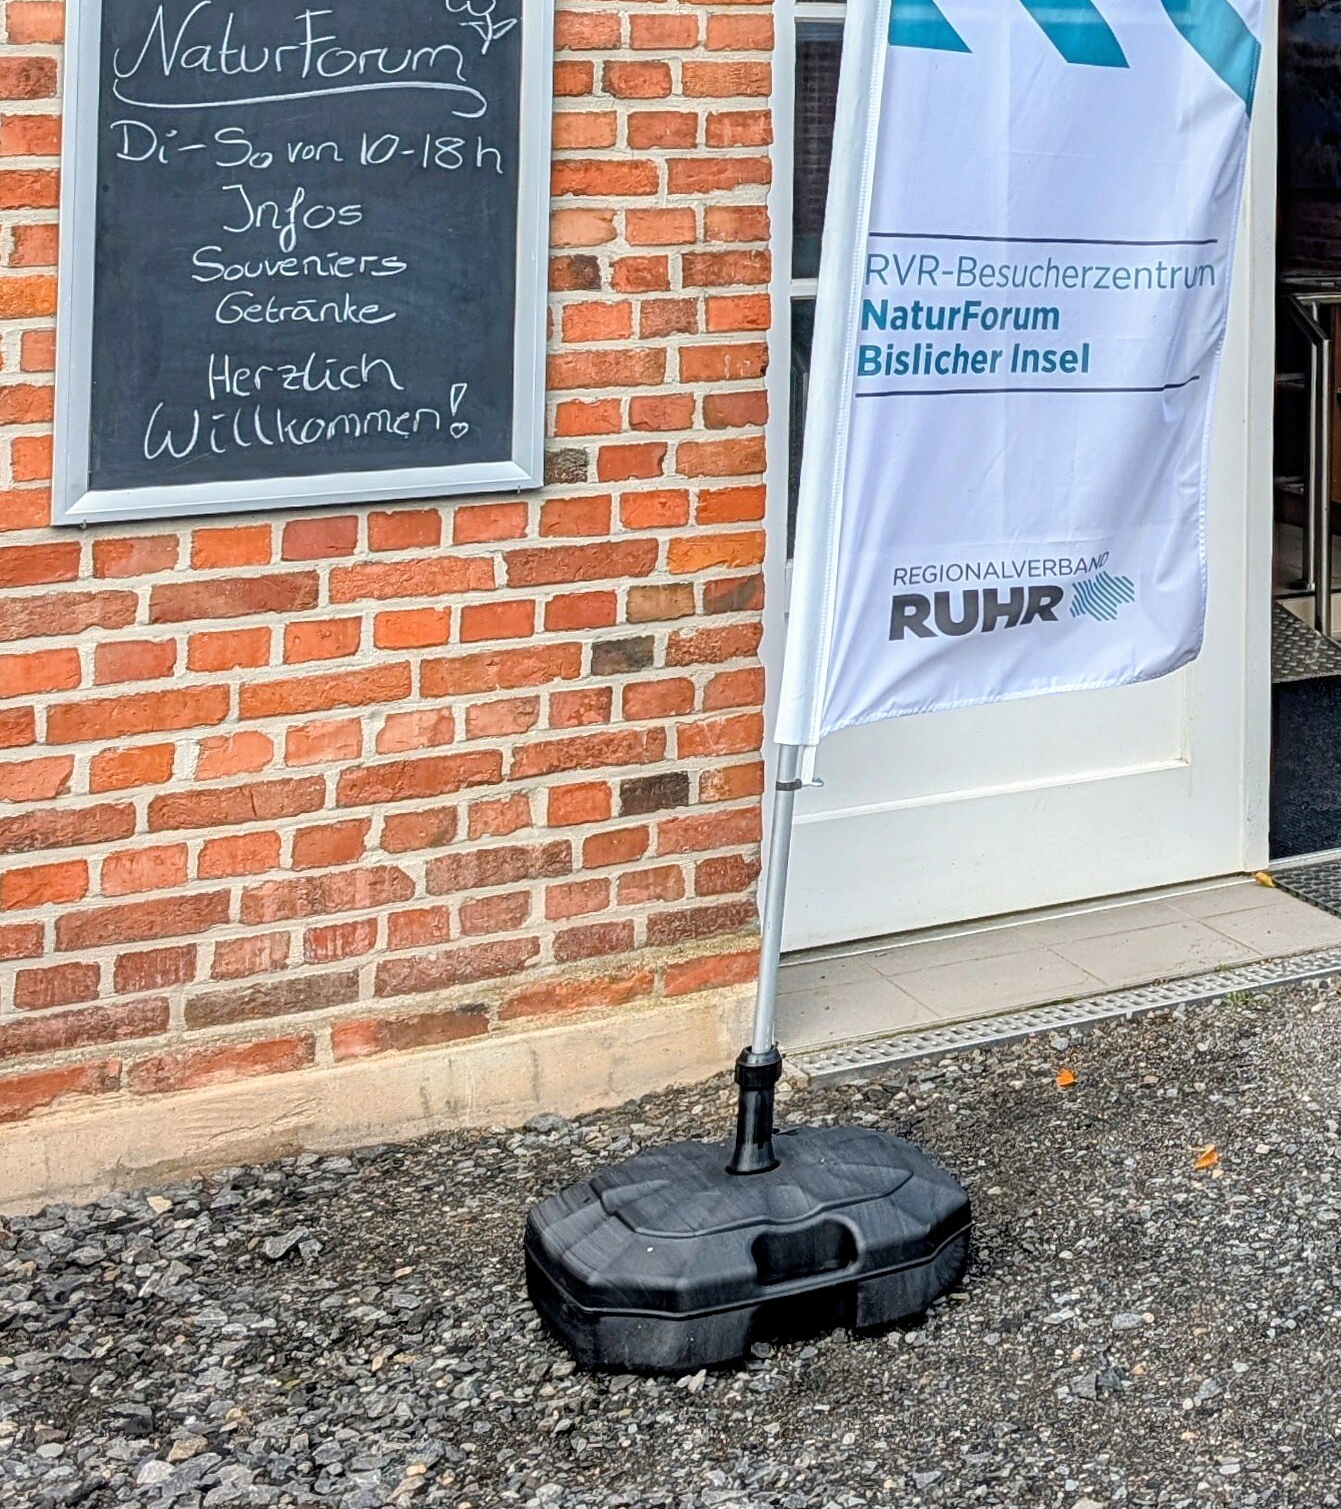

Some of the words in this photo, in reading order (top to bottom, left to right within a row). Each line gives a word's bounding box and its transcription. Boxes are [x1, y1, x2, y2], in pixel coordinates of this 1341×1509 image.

[113, 0, 468, 79] NaturForum
[287, 140, 344, 165] von
[192, 246, 407, 283] Souveniers
[215, 292, 397, 324] Getränke
[861, 298, 1060, 331] NaturForum
[209, 353, 403, 401] Herzlich
[857, 343, 1003, 377] Bislicher
[1009, 343, 1090, 374] Insel
[893, 551, 1109, 587] REGIONALVERBAND
[889, 584, 1065, 641] RUHR
